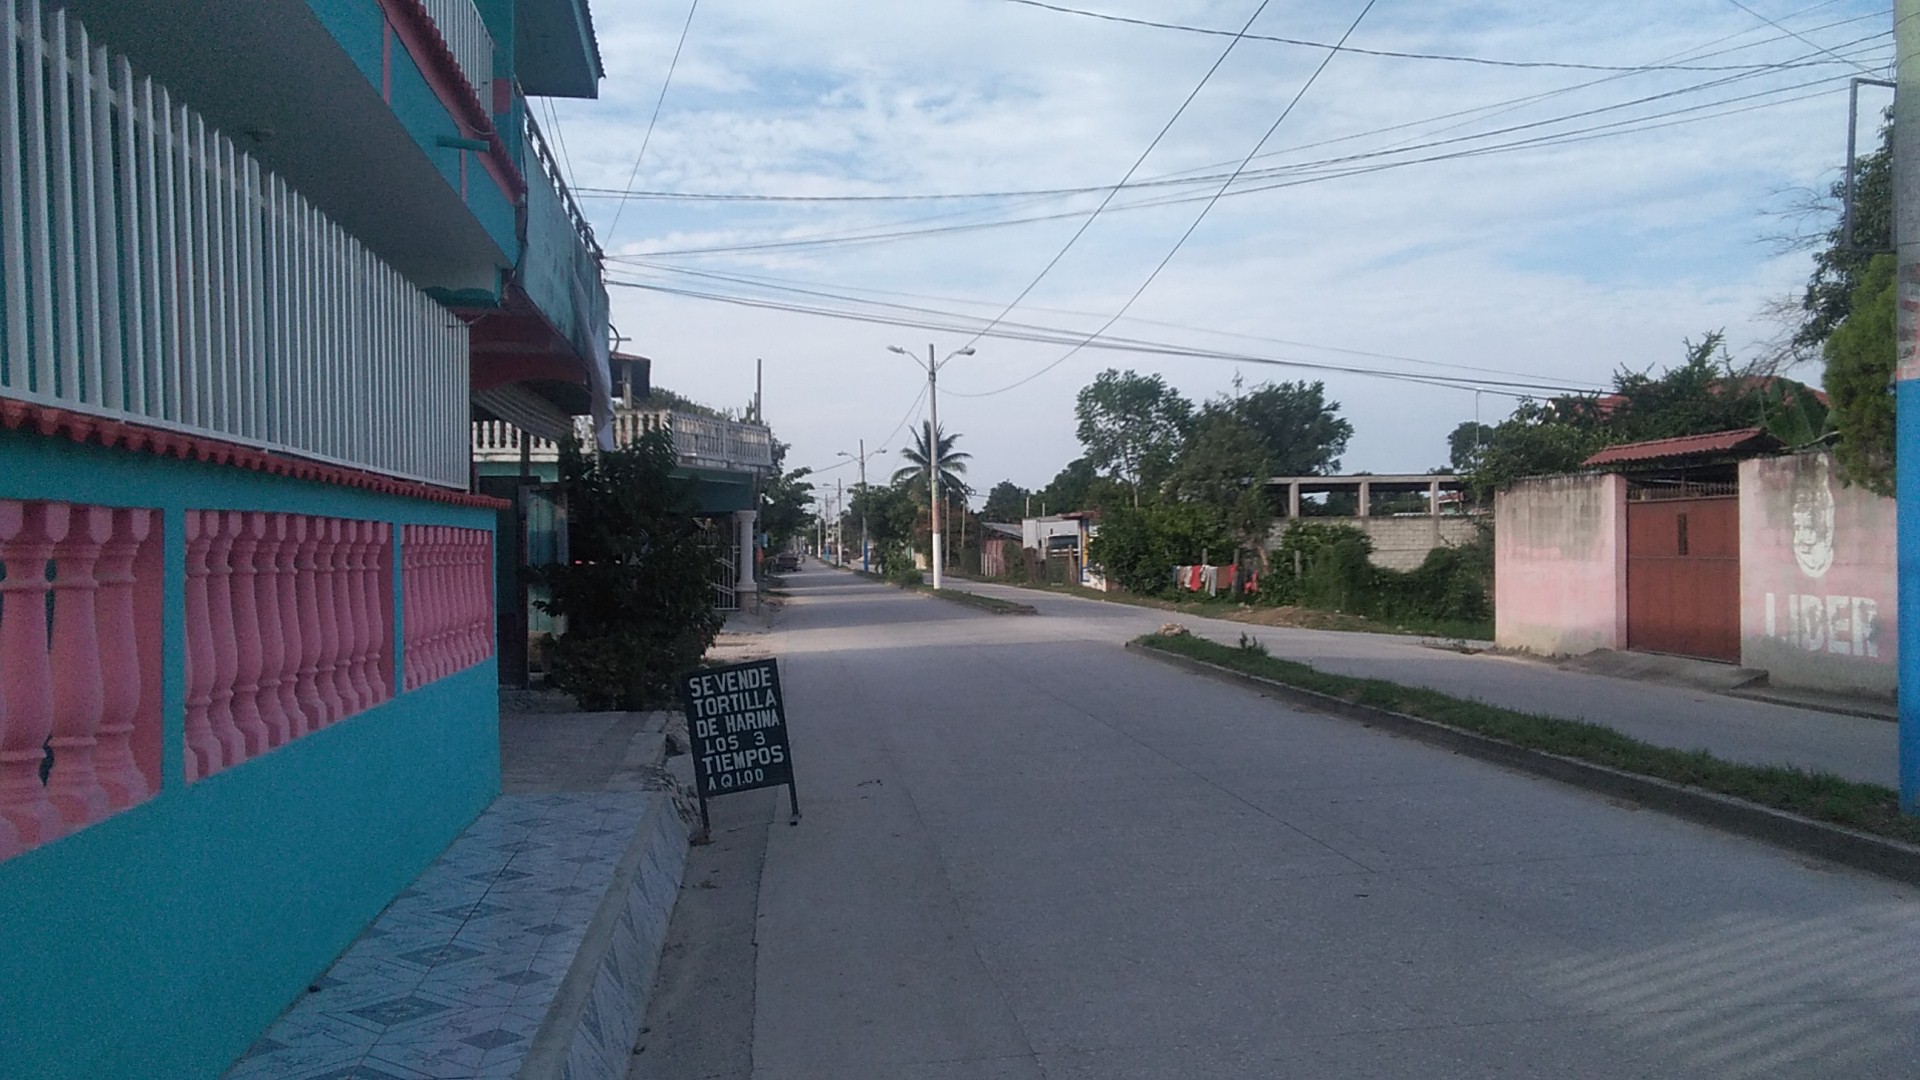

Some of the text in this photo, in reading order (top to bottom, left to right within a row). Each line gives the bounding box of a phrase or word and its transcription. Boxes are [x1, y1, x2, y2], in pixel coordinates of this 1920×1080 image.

[693, 688, 777, 717] TORTILLA
[697, 709, 780, 738] DE HARINA
[705, 731, 765, 755] LOS 3
[702, 745, 784, 775] TIEMPOS
